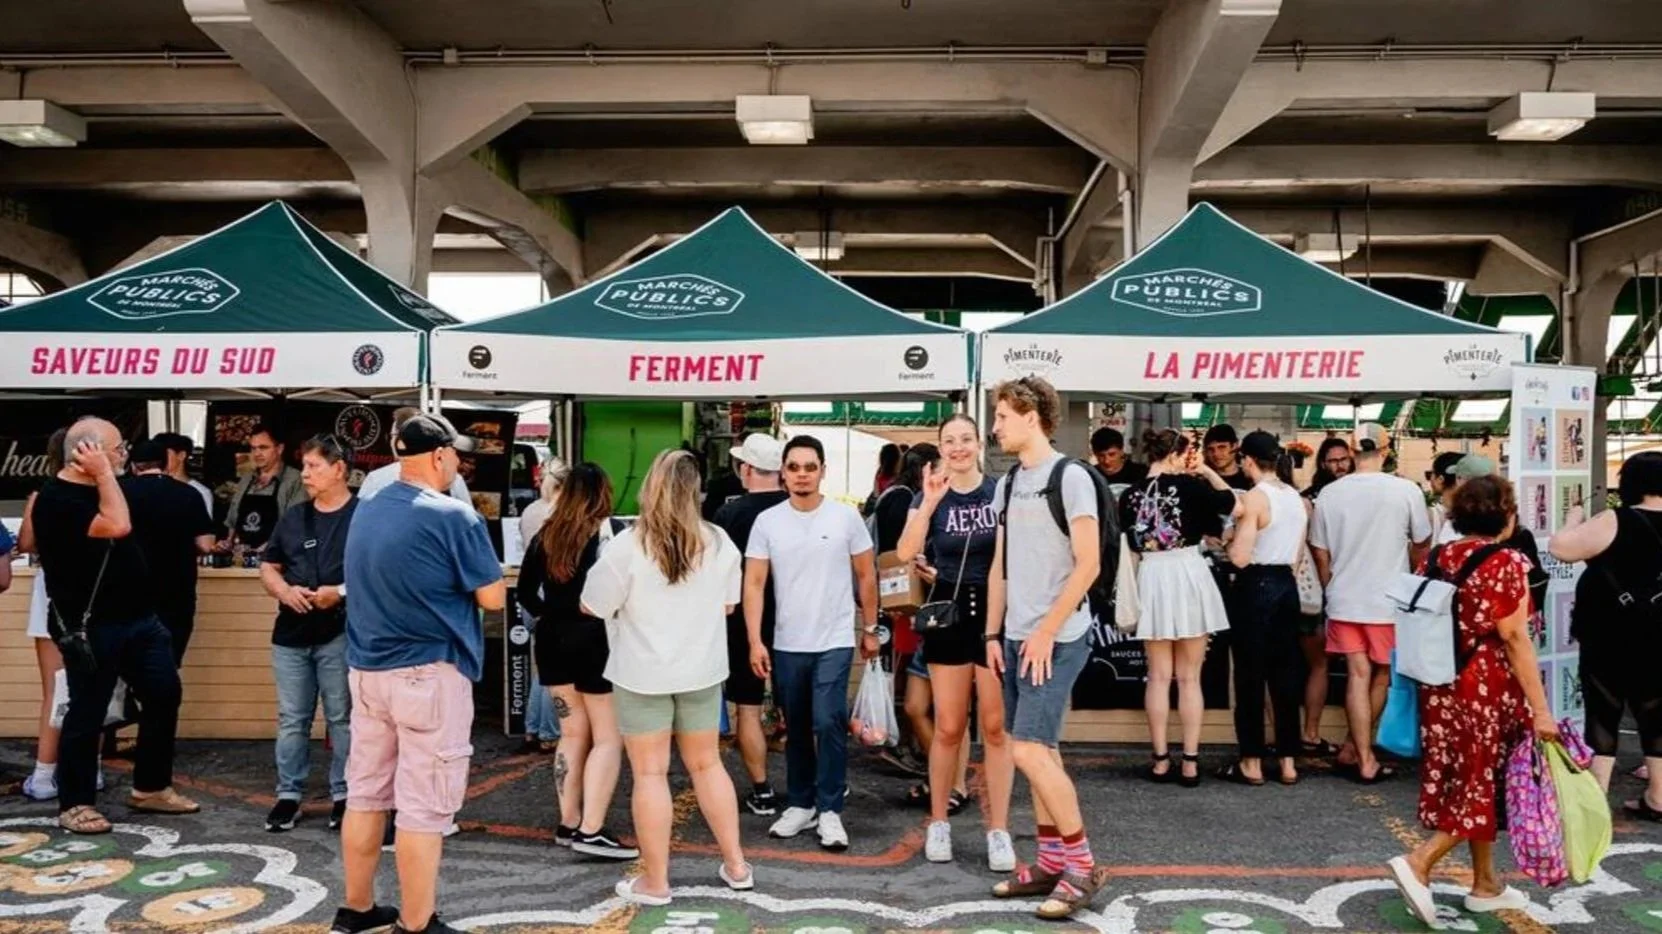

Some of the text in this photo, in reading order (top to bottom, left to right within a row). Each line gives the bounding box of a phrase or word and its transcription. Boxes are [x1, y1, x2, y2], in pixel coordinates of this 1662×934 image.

[140, 275, 219, 291] MARCHÉS
[637, 281, 720, 295] MARCHÉS
[1143, 275, 1234, 290] MARCHÉS
[107, 284, 221, 304] PUBLICS
[610, 289, 730, 307] PUBLICS
[1123, 284, 1249, 302] PUBLICS
[31, 347, 276, 375] SAVEURS DU SUD
[1003, 348, 1063, 366] PIMENTERIE
[1144, 350, 1364, 380] LA PIMENTERIE
[1443, 348, 1504, 365] PIMENTERIE
[629, 353, 764, 383] FERMENT
[0, 440, 51, 477] hea
[945, 504, 996, 533] AERO
[1110, 650, 1142, 658] SAUCES
[511, 655, 523, 715] Ferment
